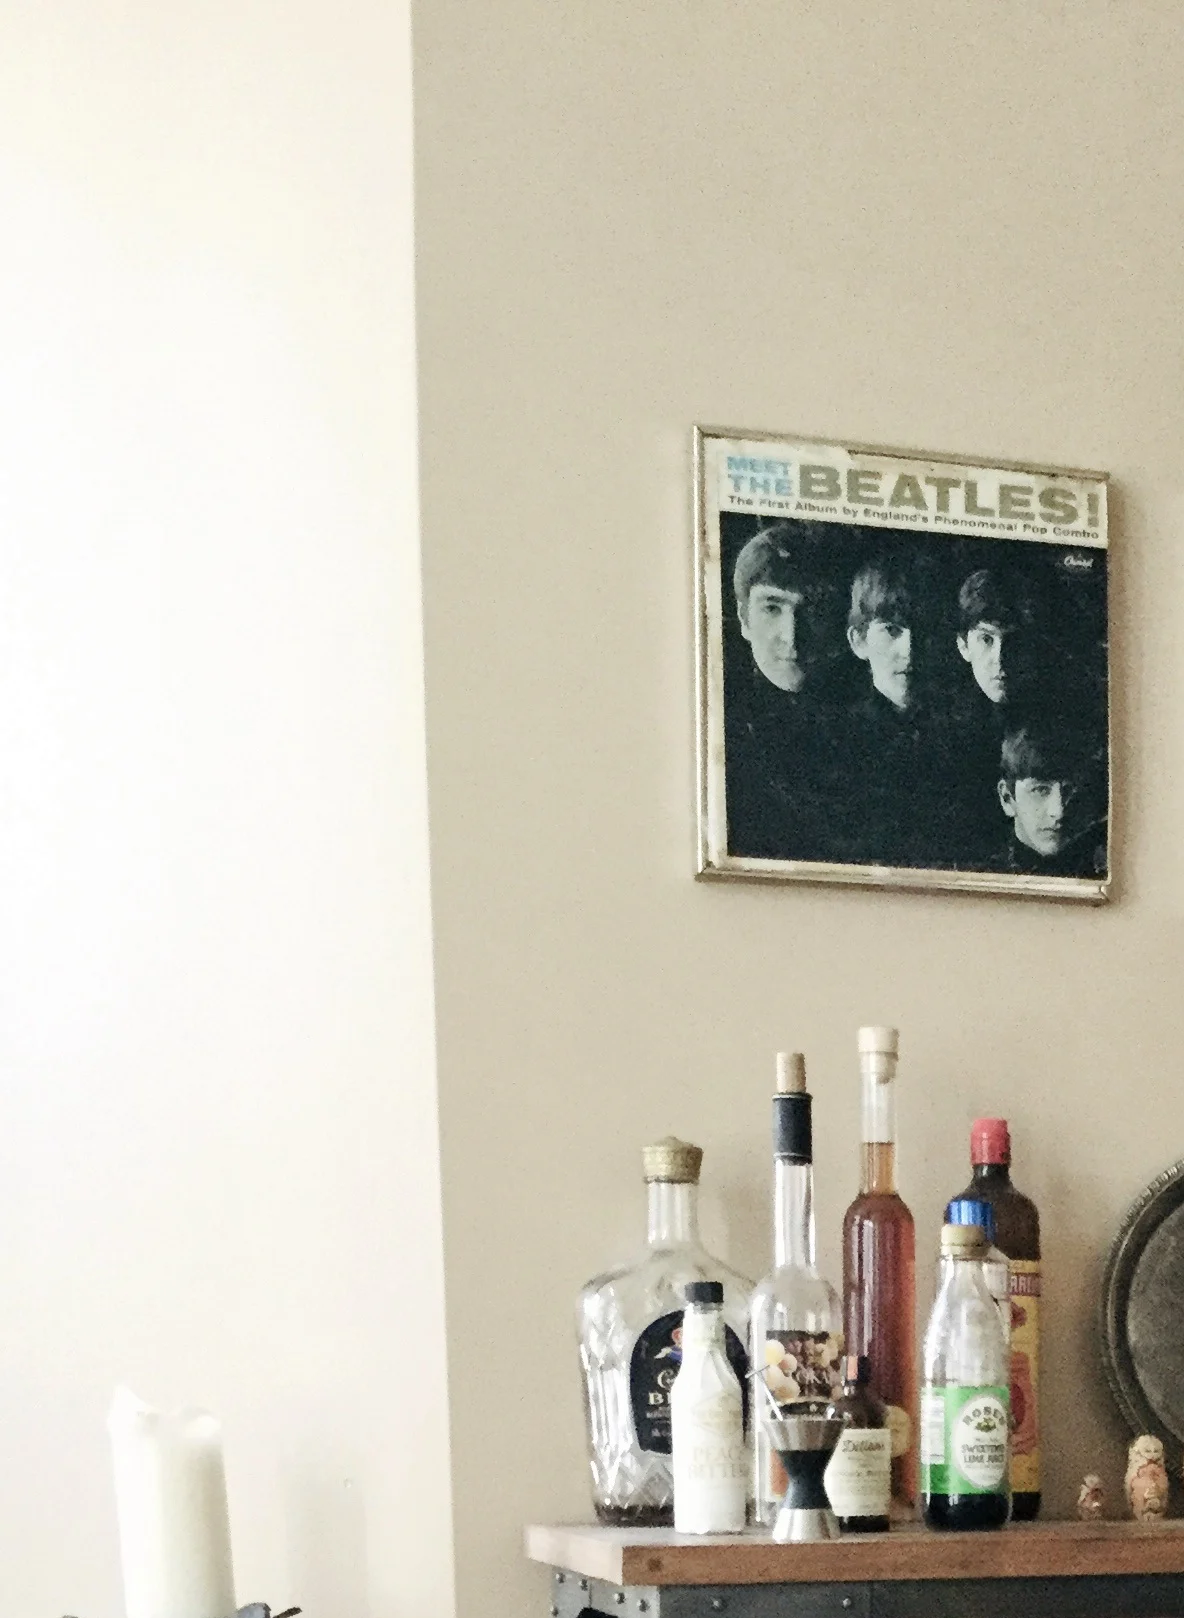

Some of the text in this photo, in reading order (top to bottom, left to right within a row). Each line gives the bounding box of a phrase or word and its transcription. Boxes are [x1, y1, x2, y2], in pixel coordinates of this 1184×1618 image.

[727, 456, 791, 476] MEET
[727, 464, 1099, 528] THE BEATLES!
[728, 495, 1100, 540] The First Album by England's Phenomenal Pop Combo
